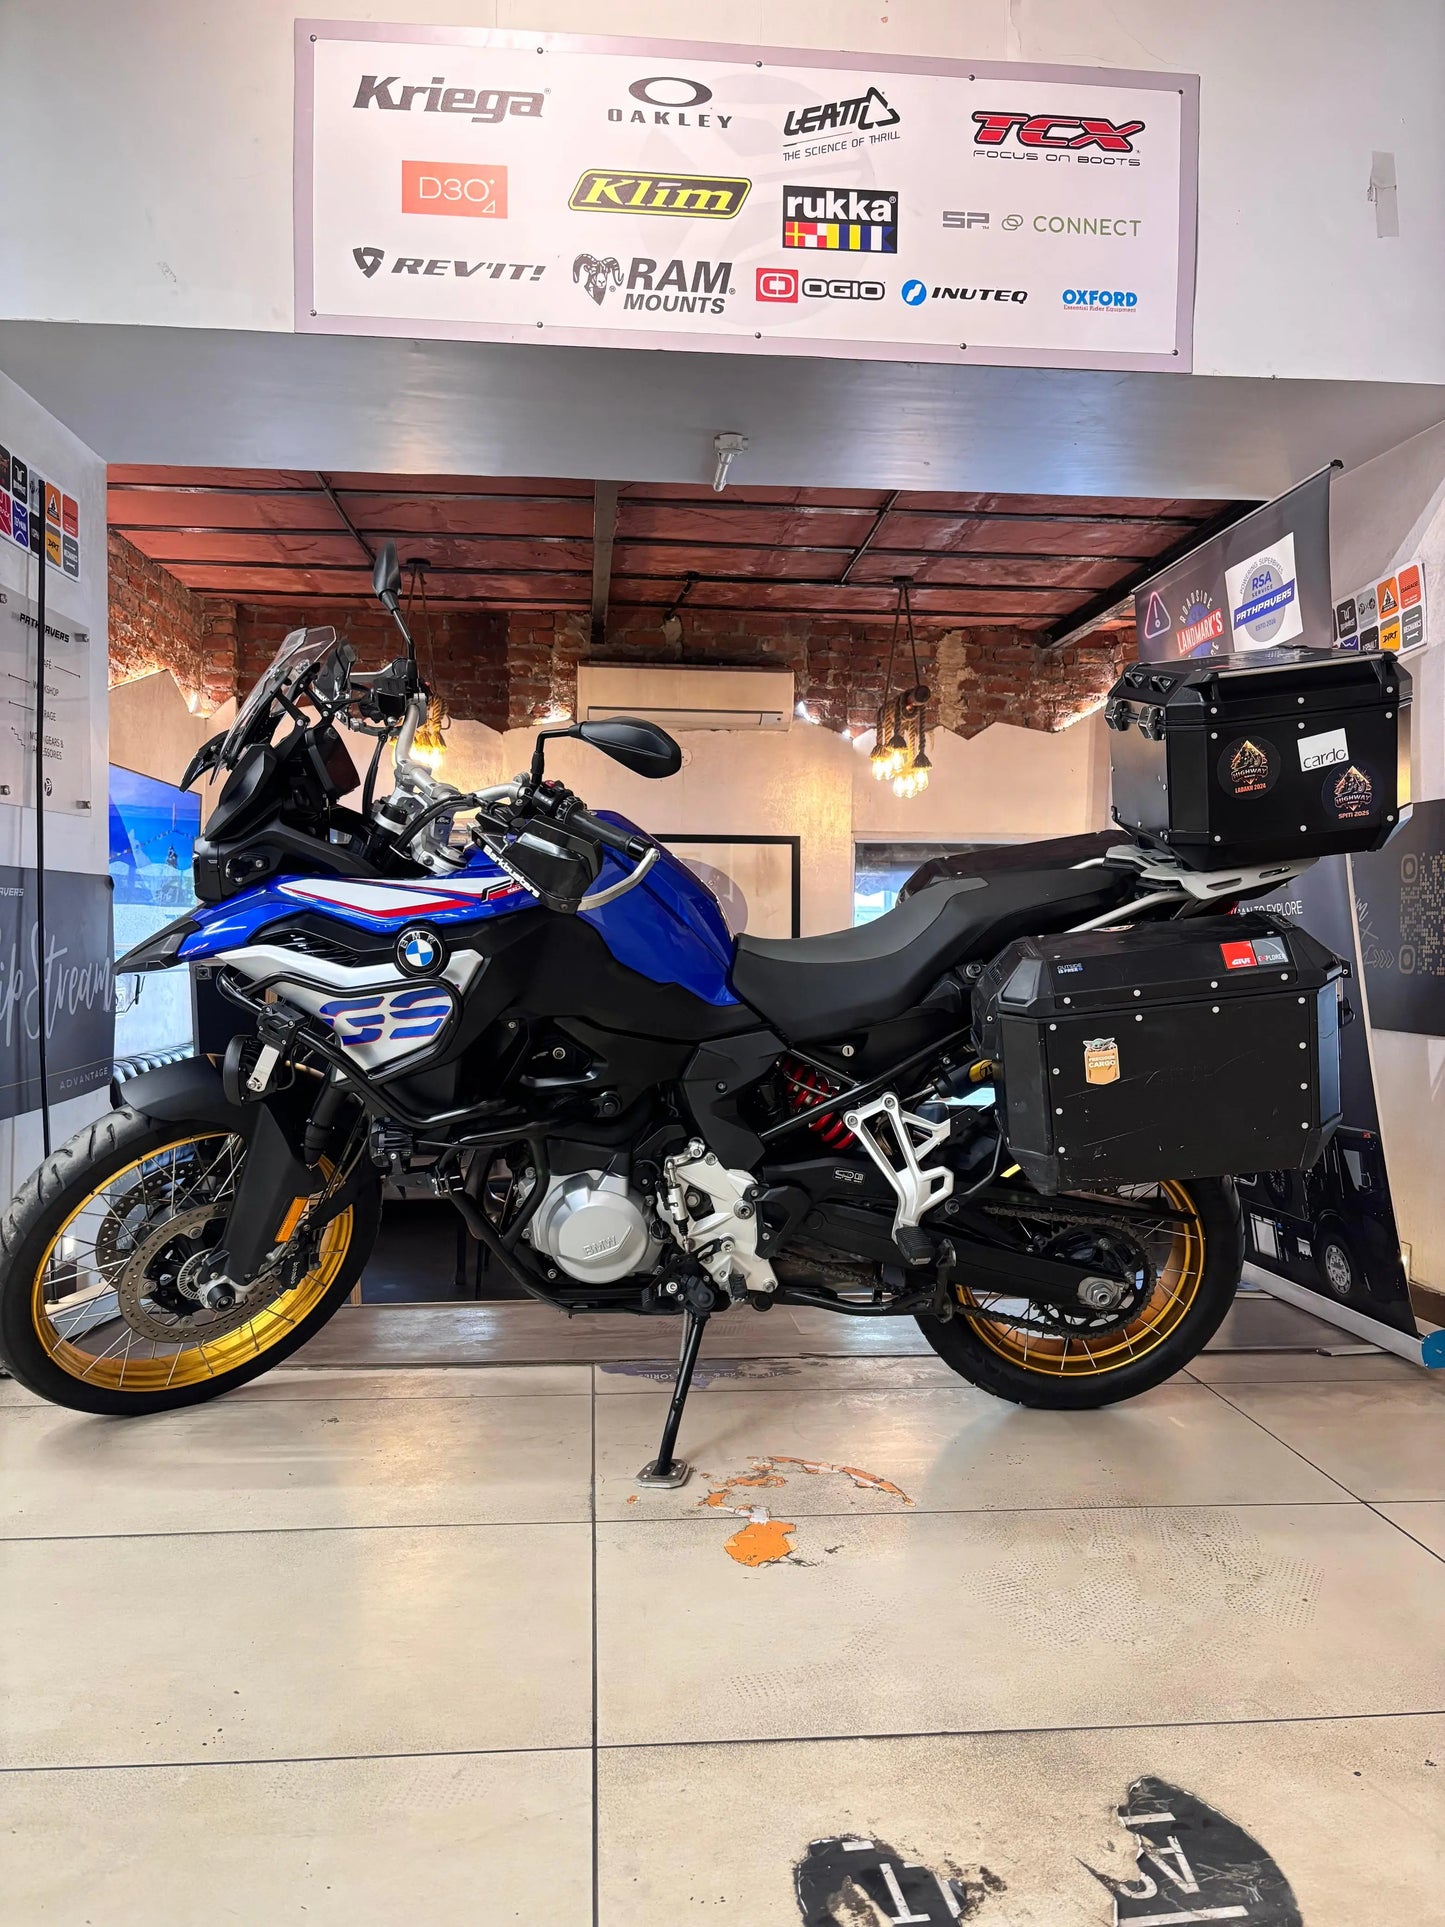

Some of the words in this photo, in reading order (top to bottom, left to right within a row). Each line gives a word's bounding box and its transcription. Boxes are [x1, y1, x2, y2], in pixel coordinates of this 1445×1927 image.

[353, 75, 543, 123] Kriega
[608, 108, 733, 129] OAKLEY
[971, 110, 1146, 153] TCX
[783, 150, 802, 162] THE
[804, 142, 848, 159] SCIENCE
[851, 138, 866, 149] OF
[869, 130, 901, 146] THRILL
[973, 149, 1039, 161] FOCUS
[1046, 152, 1071, 163] ON
[1077, 154, 1142, 167] BOOTS
[580, 177, 732, 212] Klim
[787, 191, 893, 223] rukka
[1033, 214, 1142, 237] CONNECT
[391, 257, 547, 282] REV'IT!
[627, 257, 733, 294] RAM
[801, 278, 886, 301] OGIO
[931, 286, 1029, 305] INUTEQ
[1062, 289, 1138, 307] OXFORD
[623, 293, 726, 315] MOUNTS
[1251, 571, 1273, 591] RSA
[1251, 584, 1273, 598] SERVICE
[1179, 589, 1213, 624] ROADSIDE
[1236, 587, 1293, 623] PATHPAVERS
[1176, 610, 1224, 653] LANDMARK'S
[1303, 747, 1347, 769] cardo
[1233, 766, 1268, 780] HIGHWAY
[1336, 793, 1370, 806] HIGHWAY
[483, 844, 540, 898] Barkbusters
[1231, 957, 1251, 966] GIVI
[319, 987, 451, 1046] GS
[1088, 1060, 1116, 1068] CARGO
[59, 1066, 109, 1091] ADVANTAGE
[583, 1235, 618, 1256] BMW
